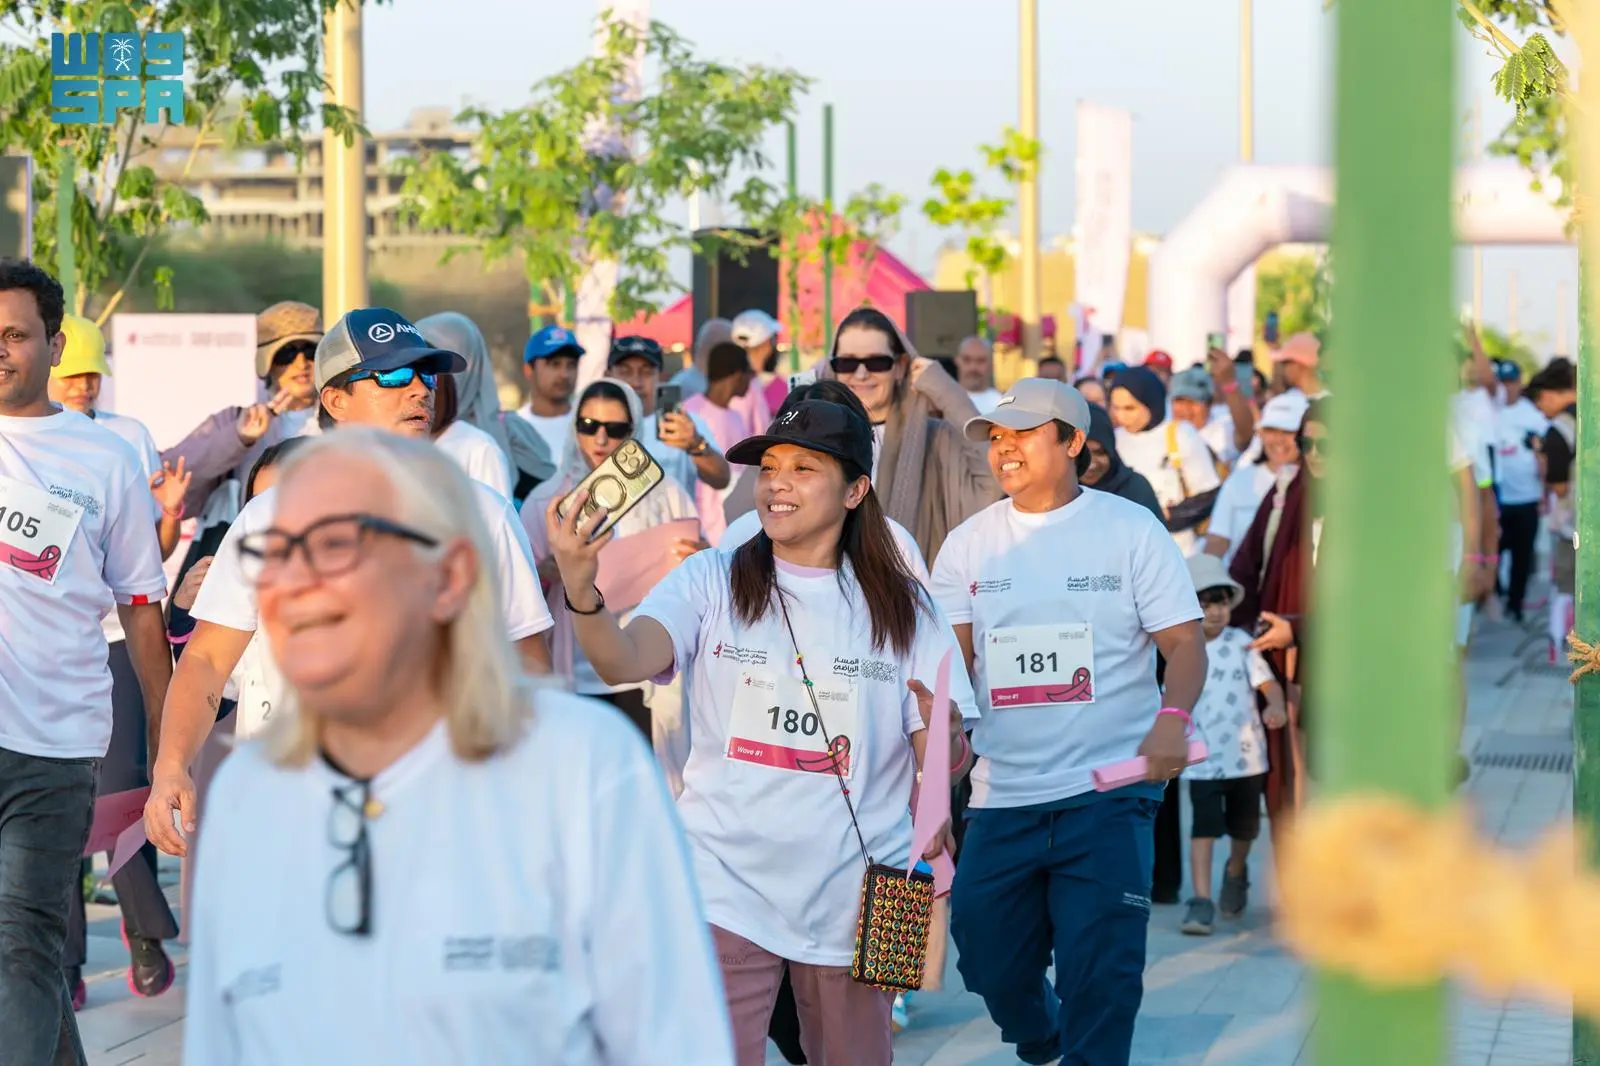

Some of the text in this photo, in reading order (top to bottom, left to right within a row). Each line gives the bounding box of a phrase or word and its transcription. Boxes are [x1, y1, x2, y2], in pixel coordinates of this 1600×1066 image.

[833, 656, 859, 665] المسار
[1015, 652, 1058, 674] 181
[833, 664, 859, 674] الرياضي
[767, 706, 819, 736] 180
[736, 745, 764, 758] Wave #1
